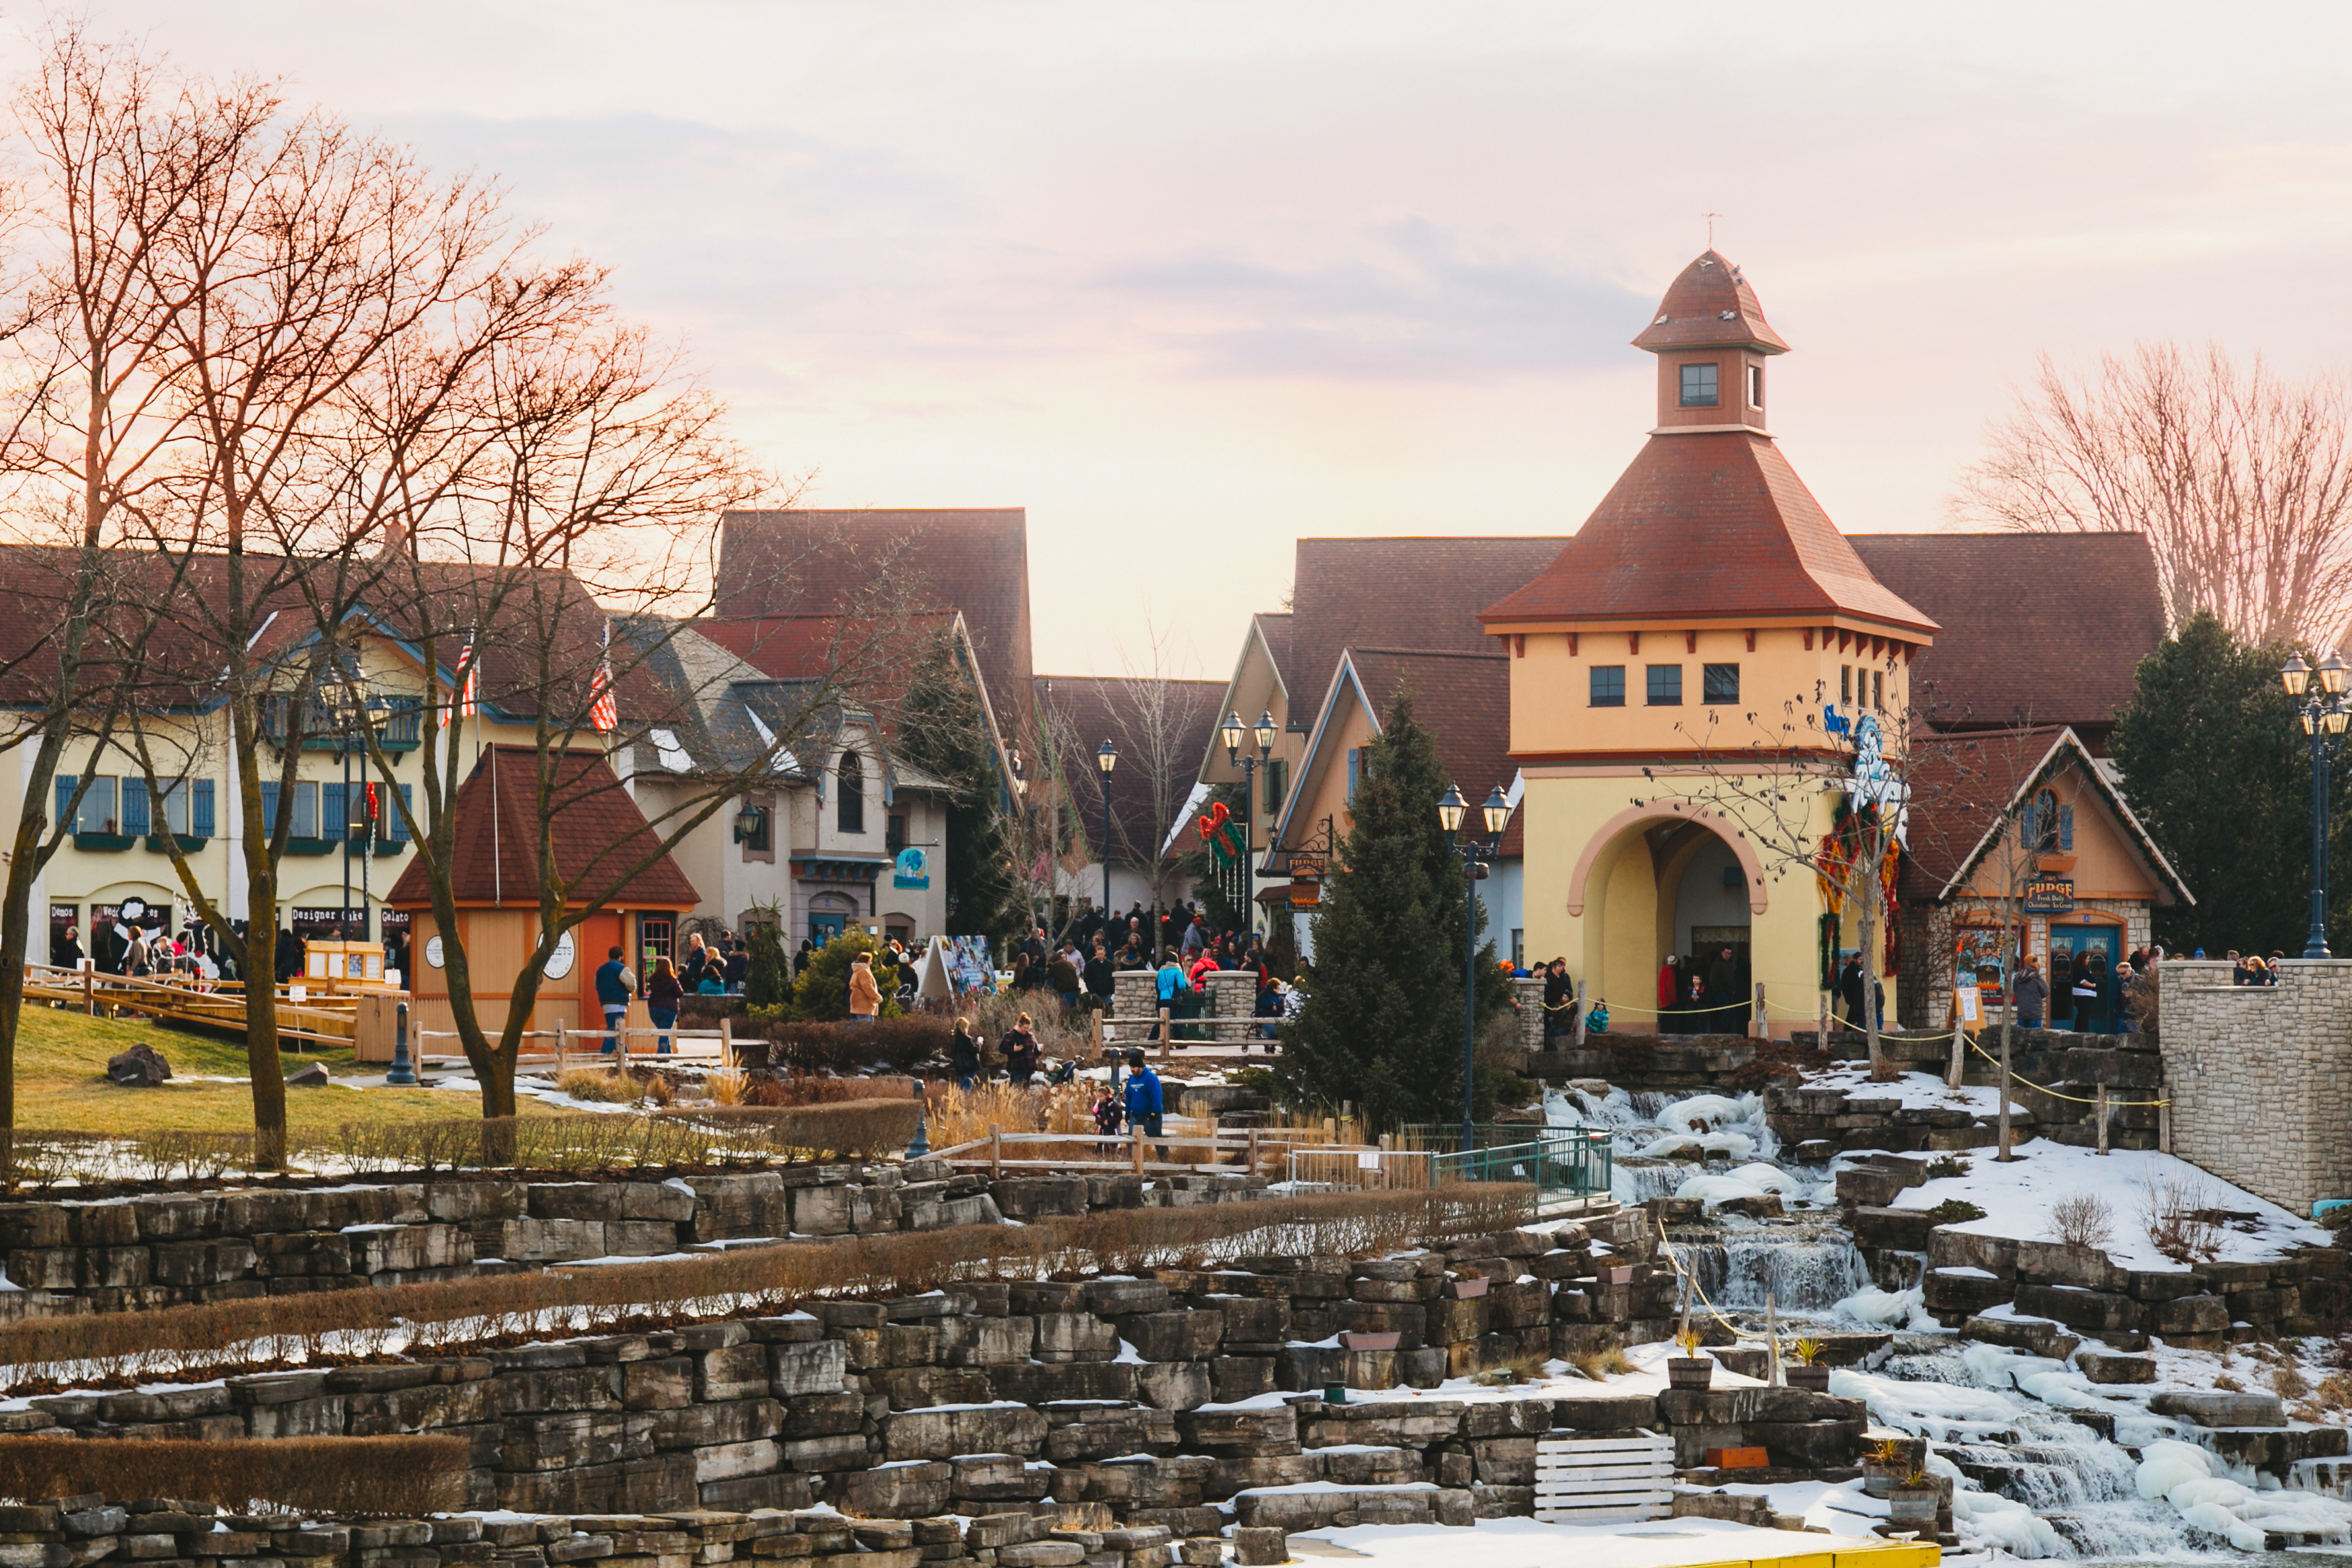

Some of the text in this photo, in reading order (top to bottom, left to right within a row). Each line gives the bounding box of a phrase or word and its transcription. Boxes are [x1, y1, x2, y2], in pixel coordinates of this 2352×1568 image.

[1824, 704, 1850, 741] Shop
[1289, 859, 1323, 870] FUDGE
[2028, 883, 2072, 900] FUDGE
[51, 906, 73, 917] Demos
[292, 910, 336, 922] Designer
[382, 911, 409, 922] Gelato
[1975, 948, 2002, 959] FUDGE
